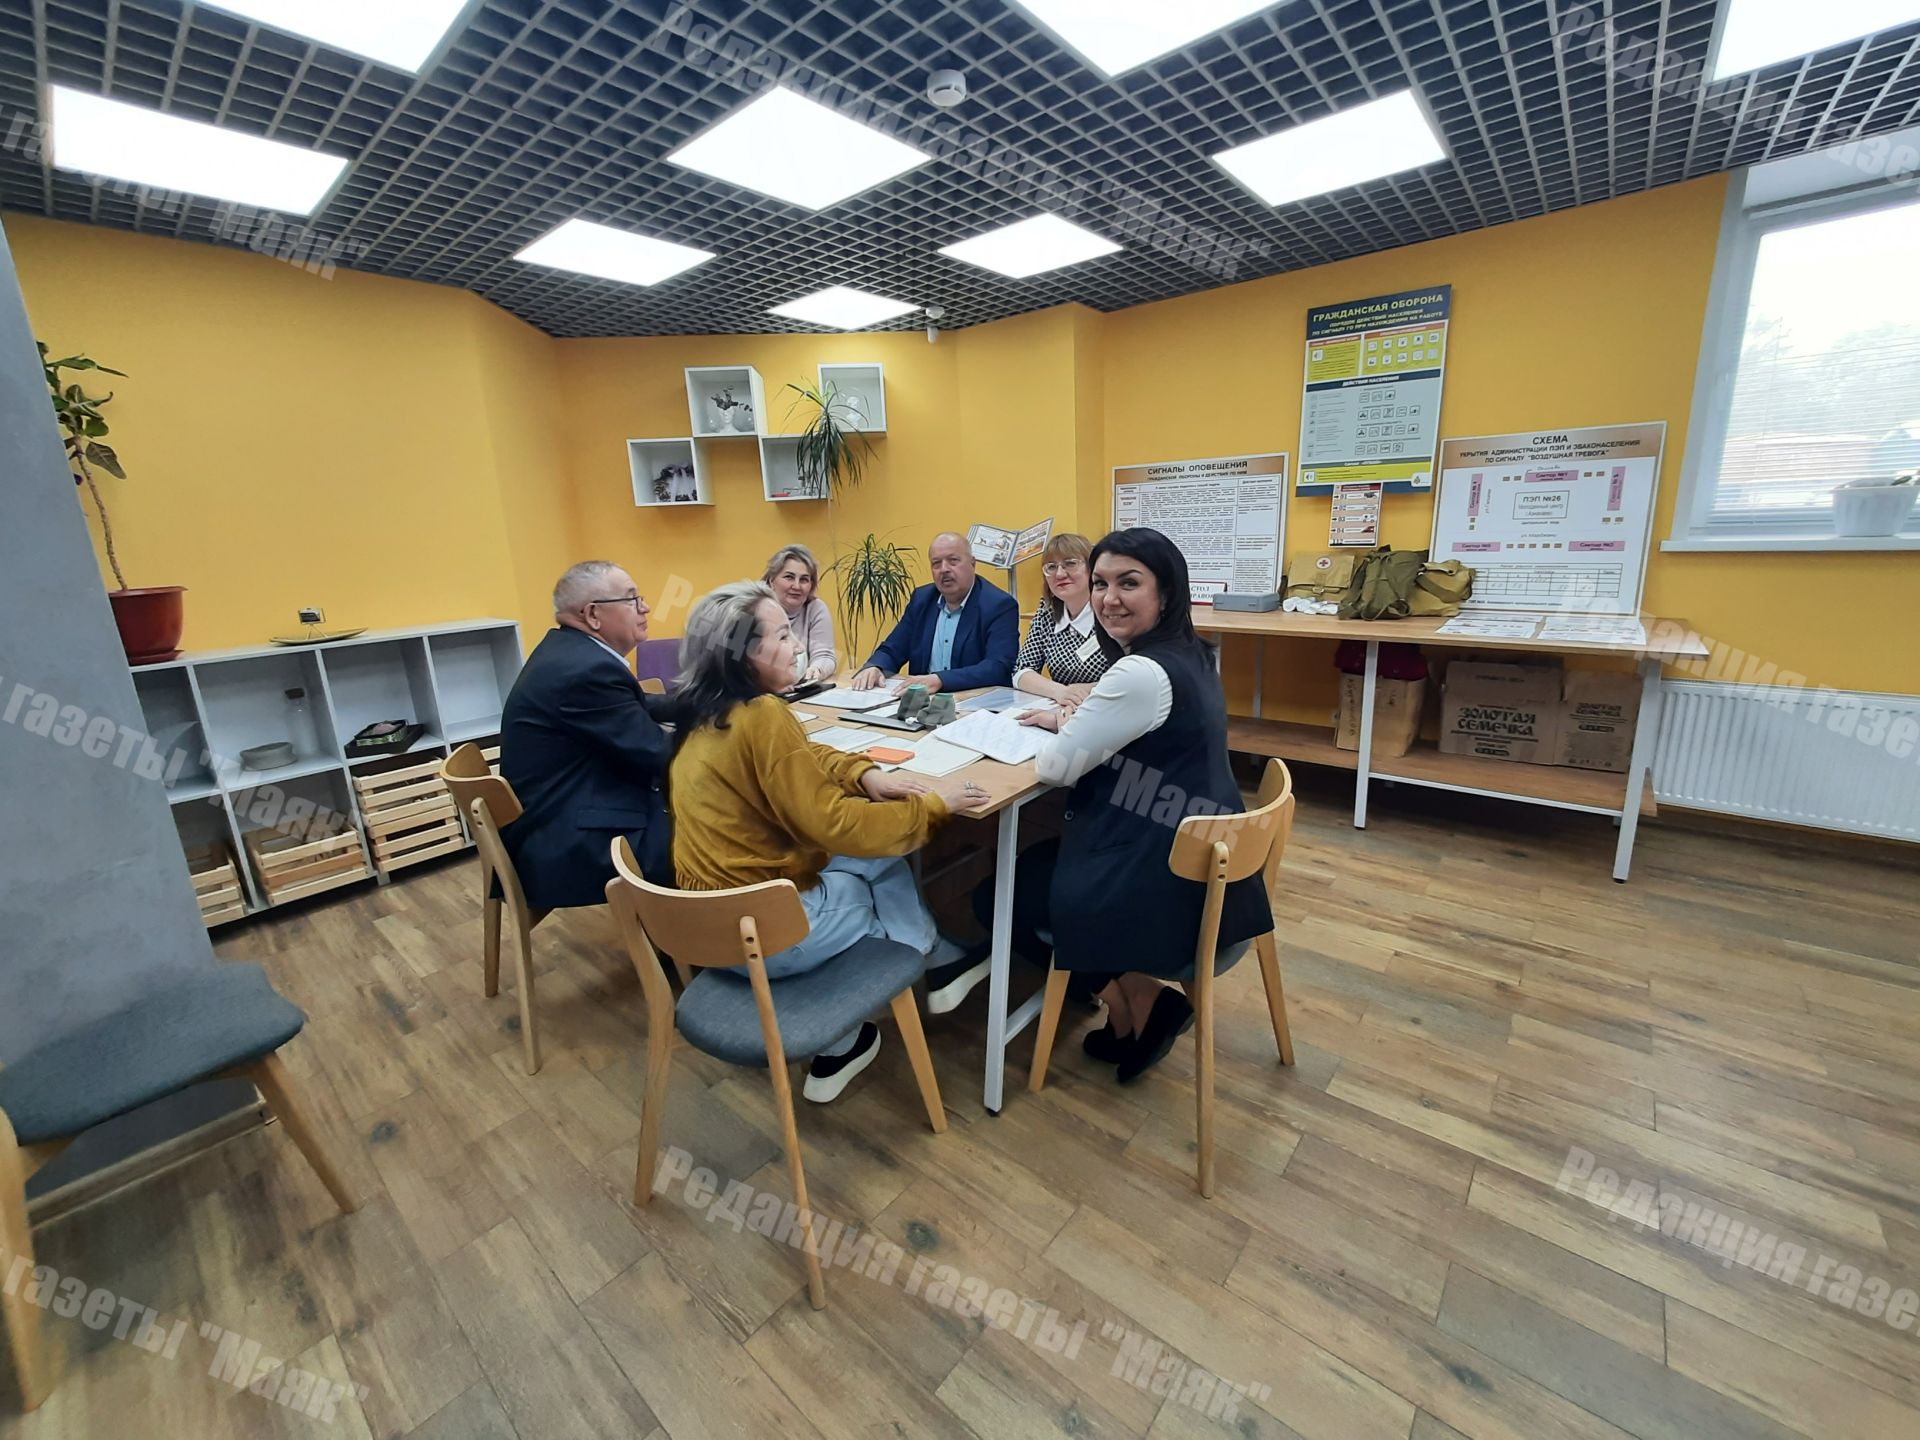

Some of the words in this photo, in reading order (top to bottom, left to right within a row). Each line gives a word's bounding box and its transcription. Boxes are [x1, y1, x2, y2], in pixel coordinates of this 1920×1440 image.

[1313, 303, 1388, 322] ГРАЖДАНСКАЯ
[1391, 294, 1443, 309] ОБОРОНА
[1419, 311, 1442, 319] РАБОТЕ
[1491, 446, 1548, 456] АДМИНИСТРАЦИИ
[1573, 440, 1641, 450] ЭВАКОНАСЕЛЕНИЯ
[1532, 435, 1568, 446] СХЕМА
[1495, 455, 1525, 463] СИГНАЛУ
[1528, 451, 1573, 461] "ВОЗДУШНАЯ
[1574, 449, 1610, 458] ТРЕВОГА"
[1148, 466, 1185, 475] СИГНАЛЫ
[1188, 461, 1248, 472] ОПОВЕЩЕНИЯ
[1459, 707, 1535, 723] ЗОЛОТАЯ
[1457, 719, 1534, 735] СЕМЕЧКА
